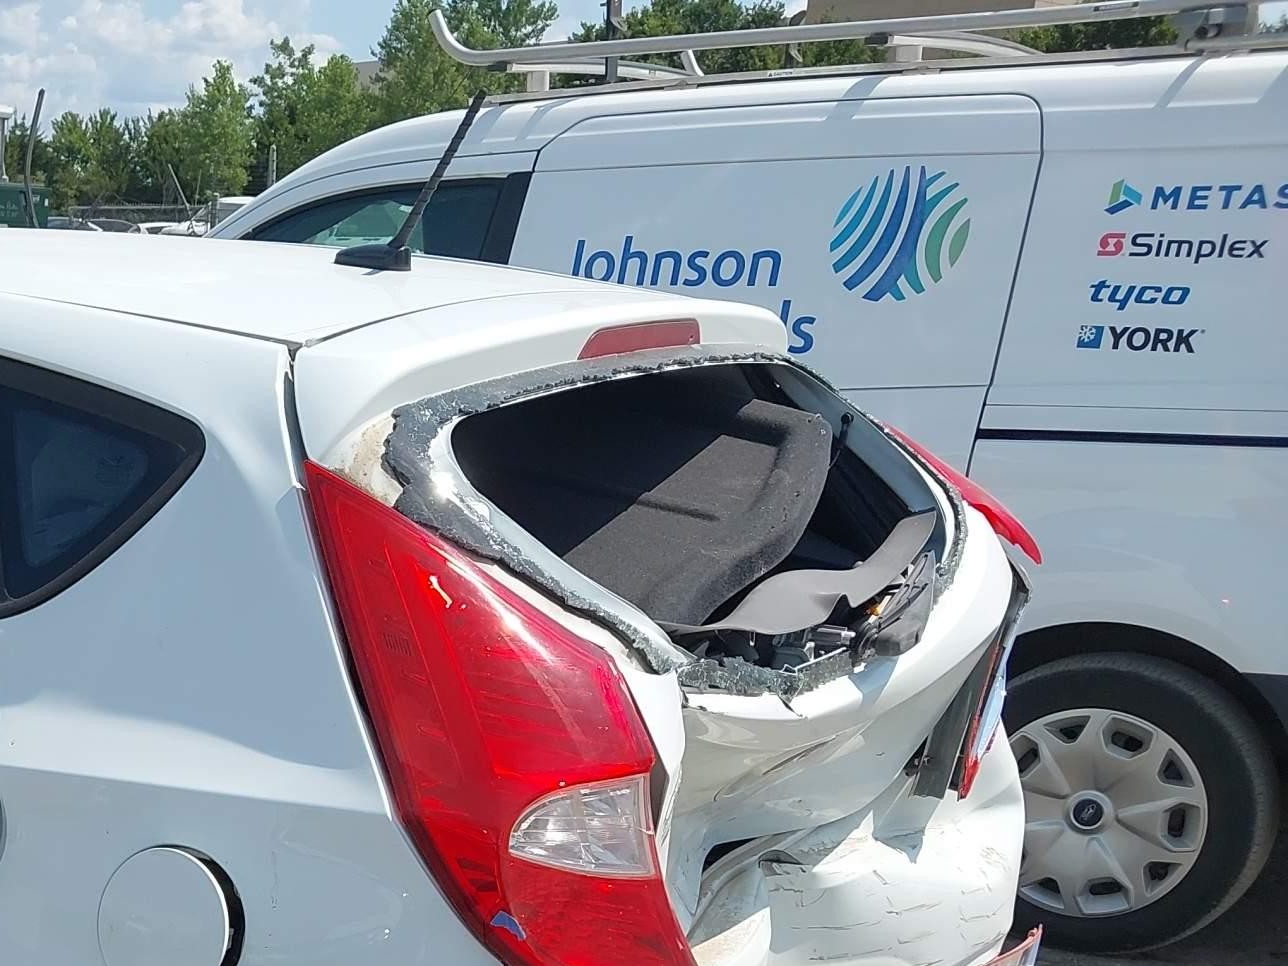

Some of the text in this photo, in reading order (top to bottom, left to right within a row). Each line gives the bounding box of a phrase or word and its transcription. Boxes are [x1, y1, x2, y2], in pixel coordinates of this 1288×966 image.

[1149, 184, 1288, 211] METAS
[570, 235, 782, 287] Johnson
[1128, 233, 1270, 264] Simplex
[1088, 279, 1191, 311] tyco
[1108, 325, 1200, 353] YORK
